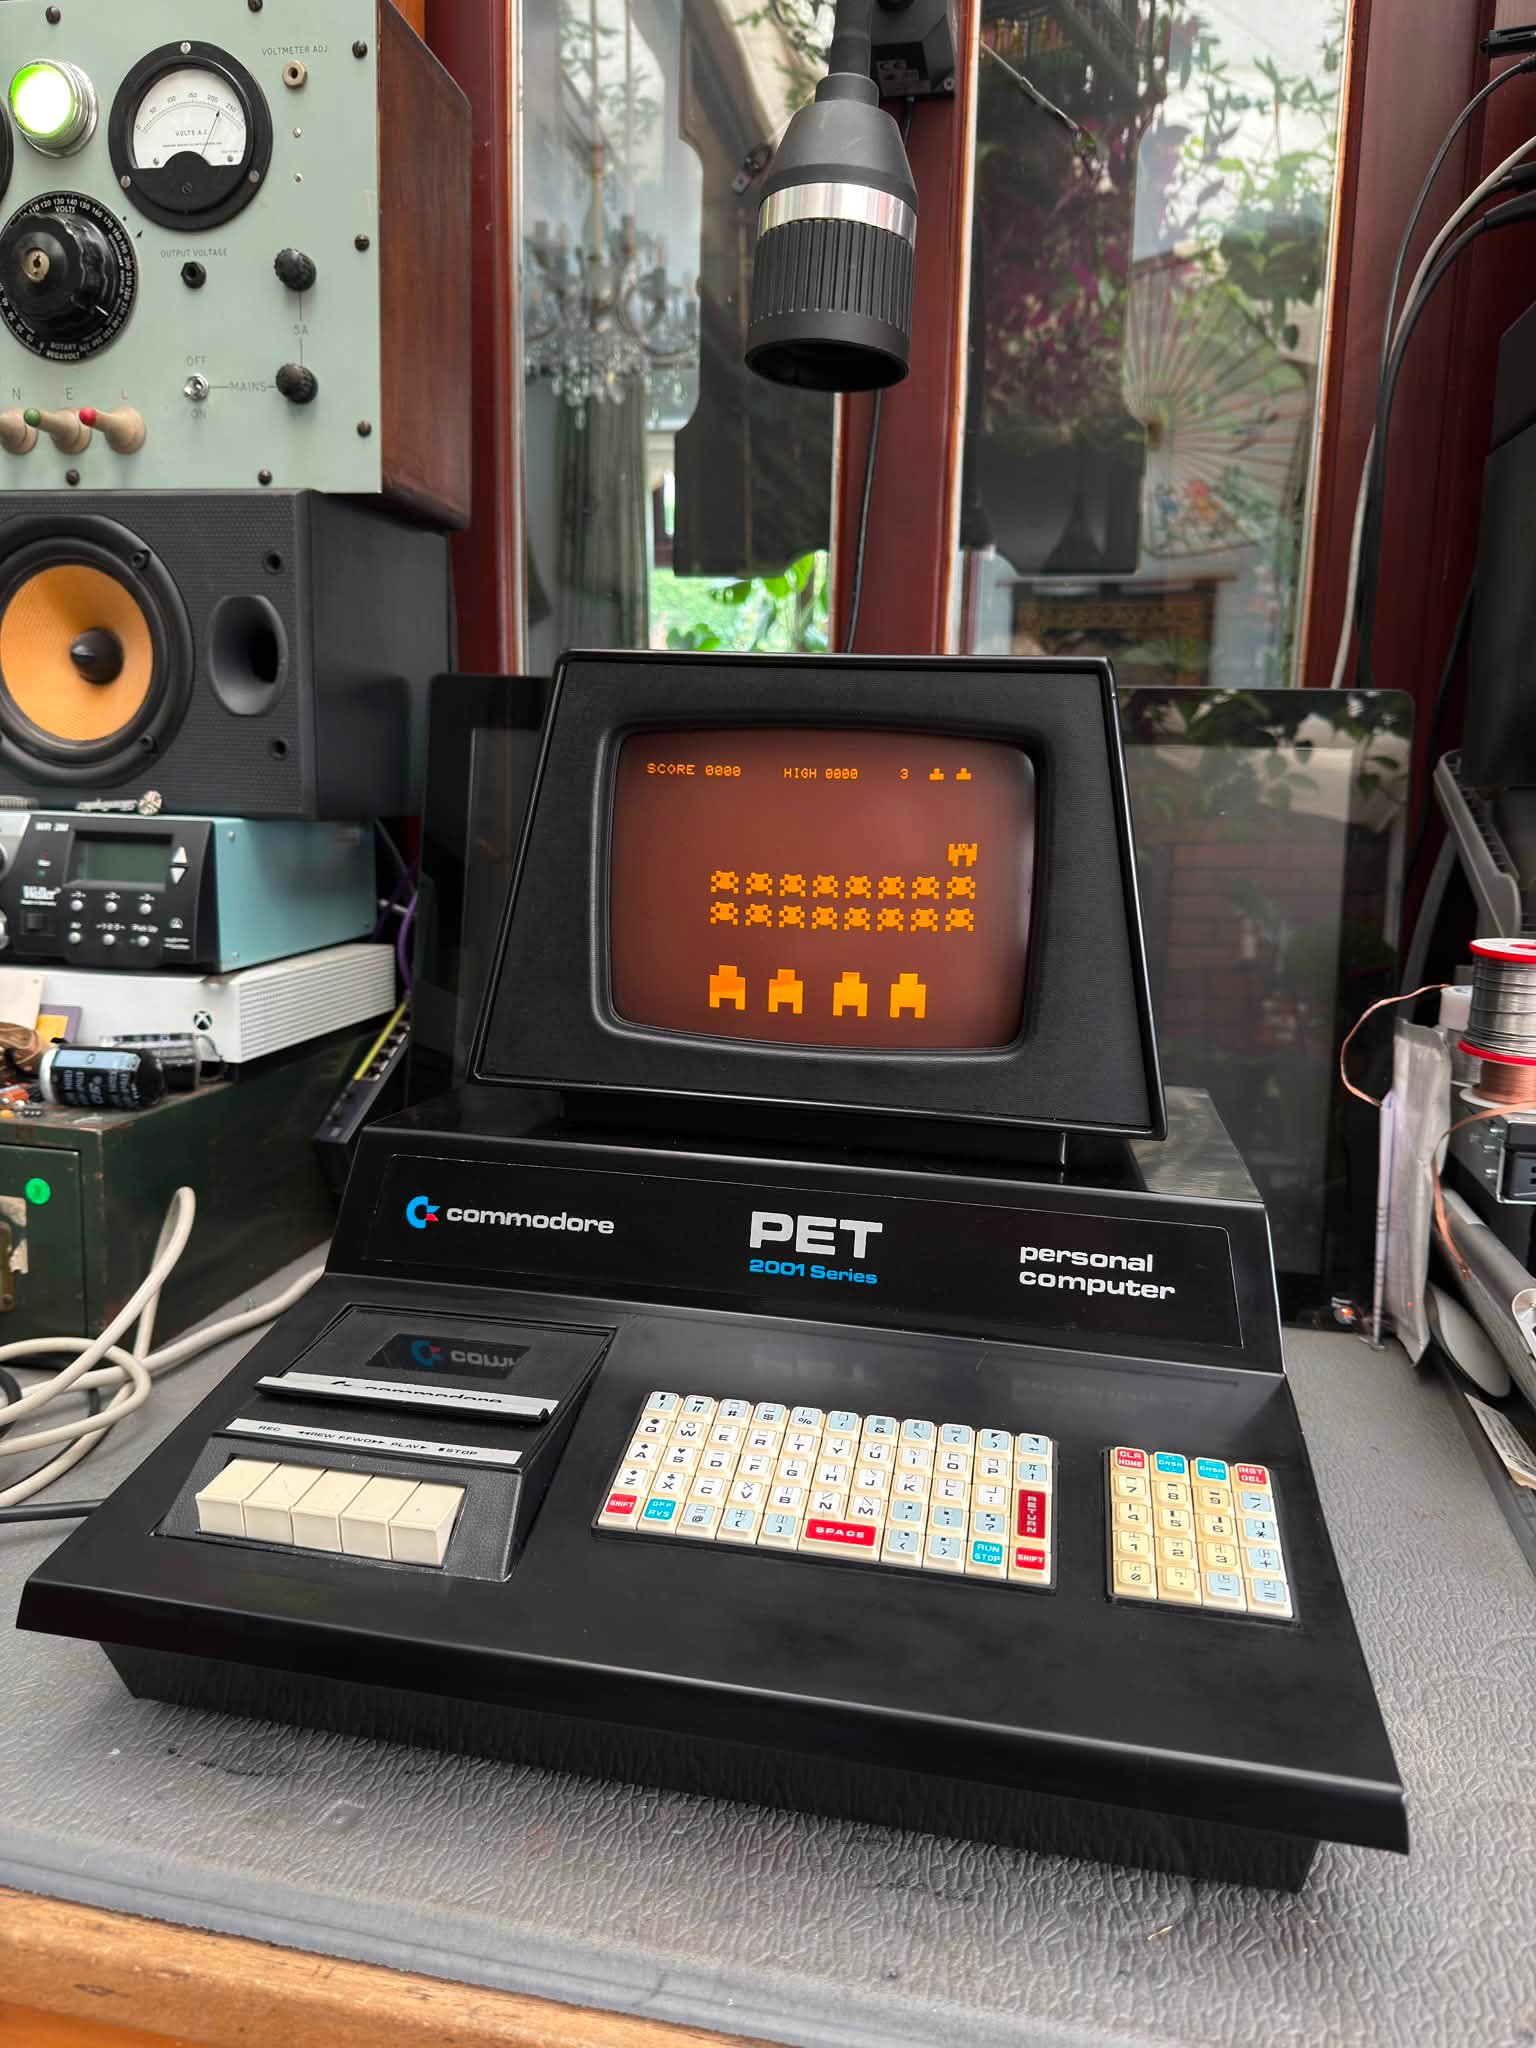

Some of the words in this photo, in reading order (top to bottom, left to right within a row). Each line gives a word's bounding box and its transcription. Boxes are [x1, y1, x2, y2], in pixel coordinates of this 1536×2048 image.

[261, 46, 309, 56] VOLTMETER
[312, 44, 328, 54] ADJ
[160, 249, 190, 258] OUTPUT
[193, 248, 228, 257] VOLTAGE
[293, 324, 309, 336] 5A
[186, 356, 207, 367] OFF
[229, 382, 266, 392] MAINS
[12, 387, 21, 400] N
[65, 387, 73, 400] E
[121, 386, 128, 400] L
[190, 408, 207, 419] ON
[647, 763, 695, 775] SCORE
[705, 765, 741, 777] 0000
[784, 768, 817, 780] HIGH
[825, 768, 858, 780] 0000
[900, 768, 909, 780] 3
[446, 1206, 615, 1234] commodore
[750, 1211, 883, 1258] PET
[1020, 1246, 1153, 1272] personal
[750, 1259, 805, 1277] 2001
[810, 1265, 878, 1284] Series
[1019, 1271, 1175, 1299] computer
[446, 1447, 478, 1455] STOP
[1119, 1451, 1142, 1459] CLR
[947, 1462, 958, 1470] O
[1119, 1459, 1143, 1467] HOME
[1158, 1459, 1183, 1467] CRSR
[609, 1500, 634, 1509] SHIFT
[819, 1502, 832, 1510] N
[647, 1509, 670, 1518] RVS
[858, 1506, 873, 1515] M
[1026, 1495, 1037, 1533] RETURN
[692, 1515, 704, 1523] @
[815, 1526, 865, 1538] SPACE
[977, 1544, 1000, 1553] RUN
[974, 1553, 1000, 1563] STOP
[1017, 1554, 1044, 1564] SHIFT
